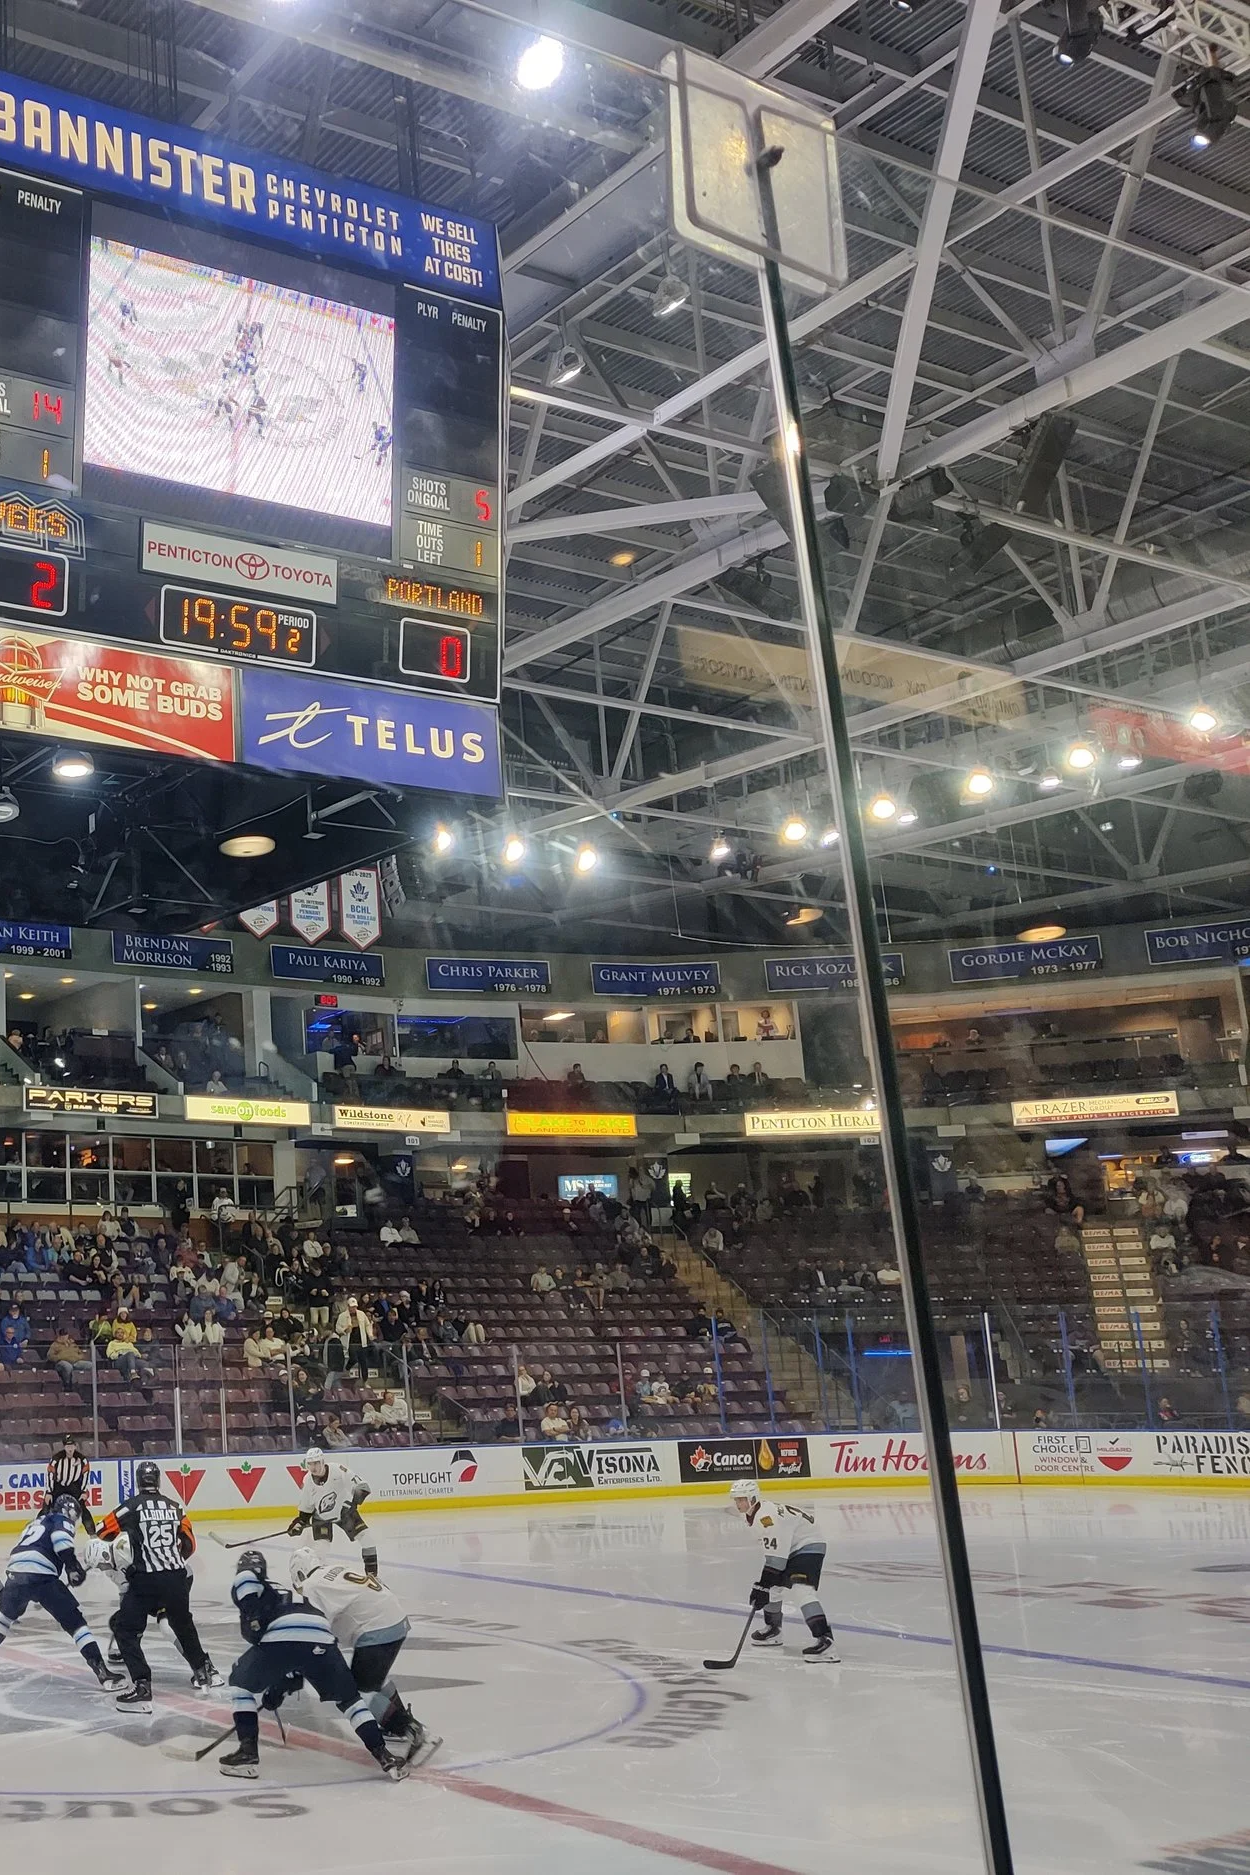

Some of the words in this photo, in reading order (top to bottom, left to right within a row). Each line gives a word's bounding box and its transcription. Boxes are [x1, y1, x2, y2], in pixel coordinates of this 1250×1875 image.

[16, 189, 63, 215] PENALTY
[266, 172, 402, 232] CHEVROLET
[267, 198, 403, 257] PENTICTON
[420, 211, 445, 237] WE
[446, 218, 479, 245] SELL
[431, 235, 472, 264] TIRES
[423, 254, 443, 278] AT
[444, 259, 484, 289] COST!
[416, 300, 439, 321] PLYR
[451, 310, 488, 333] PENALTY
[33, 390, 63, 425] 14
[411, 475, 448, 496] SHOTS
[416, 520, 444, 540] TIME
[415, 535, 444, 554] OUTS
[147, 540, 233, 570] PENTICTON
[272, 563, 333, 588] TOYOTA
[417, 549, 443, 566] LEFT
[31, 561, 58, 610] 2
[387, 577, 483, 617] PORTLAND
[181, 596, 278, 653] 19:59
[277, 612, 311, 631] PERIOD
[440, 636, 462, 679] 0
[77, 665, 123, 685] WHY
[126, 673, 166, 693] NOT
[170, 681, 223, 702] GRAB
[76, 682, 150, 711] SOME
[156, 695, 224, 722] BUDS
[346, 712, 486, 764] TELUS
[17, 926, 60, 943] KEITH
[1155, 935, 1191, 949] BOB
[10, 944, 33, 956] 1999
[44, 948, 66, 959] 2001
[125, 935, 190, 952] BRENDAN
[122, 948, 193, 967] MORRISON
[210, 953, 232, 964] 1992
[288, 952, 319, 967] PAUL
[322, 955, 368, 972] KARIYA
[961, 952, 1025, 968] GORDIE
[438, 963, 483, 978] CHRIS
[487, 965, 540, 979] PARKER
[599, 969, 647, 983] GRANT
[651, 967, 711, 982] MULVEY
[774, 963, 811, 978] RICK
[1031, 965, 1055, 976] 1973
[1073, 961, 1098, 972] 1977
[331, 974, 353, 985] 1990
[360, 976, 382, 987] 1992
[493, 983, 516, 993] 1976
[525, 984, 548, 993] 1978
[657, 986, 679, 996] 1971
[693, 985, 717, 995] 1973
[28, 1089, 153, 1107] PARKERS
[1088, 1098, 1130, 1106] MECHANICAL
[98, 1104, 118, 1114] Jeep
[210, 1105, 237, 1117] save
[237, 1107, 253, 1116] on
[254, 1105, 287, 1118] foods
[338, 1108, 394, 1121] Wildstone
[1034, 1102, 1088, 1115] FRAZER
[1108, 1108, 1170, 1118] REFRIGERATION
[751, 1116, 826, 1130] PENTICTON
[831, 1113, 879, 1129] HERAL
[564, 1179, 585, 1192] MS
[1037, 1435, 1067, 1444] FIRST
[830, 1441, 876, 1473] Tim
[882, 1438, 988, 1472] Hons
[1032, 1444, 1074, 1454] CHOICE
[574, 1448, 661, 1476] VISONA
[712, 1451, 752, 1467] Canco
[1039, 1456, 1079, 1464] WINDOW
[1034, 1464, 1059, 1472] DOOR
[1062, 1464, 1095, 1472] CENTRE
[8, 1470, 102, 1489] CANN
[392, 1471, 452, 1485] TOPFLIGHT
[597, 1476, 645, 1485] ENTERPRISES
[647, 1475, 662, 1483] LTD.
[379, 1489, 395, 1497] ELITE
[395, 1488, 423, 1497] TRAINING
[428, 1487, 454, 1495] CHARTER
[148, 1523, 173, 1548] 25
[763, 1537, 778, 1550] 24
